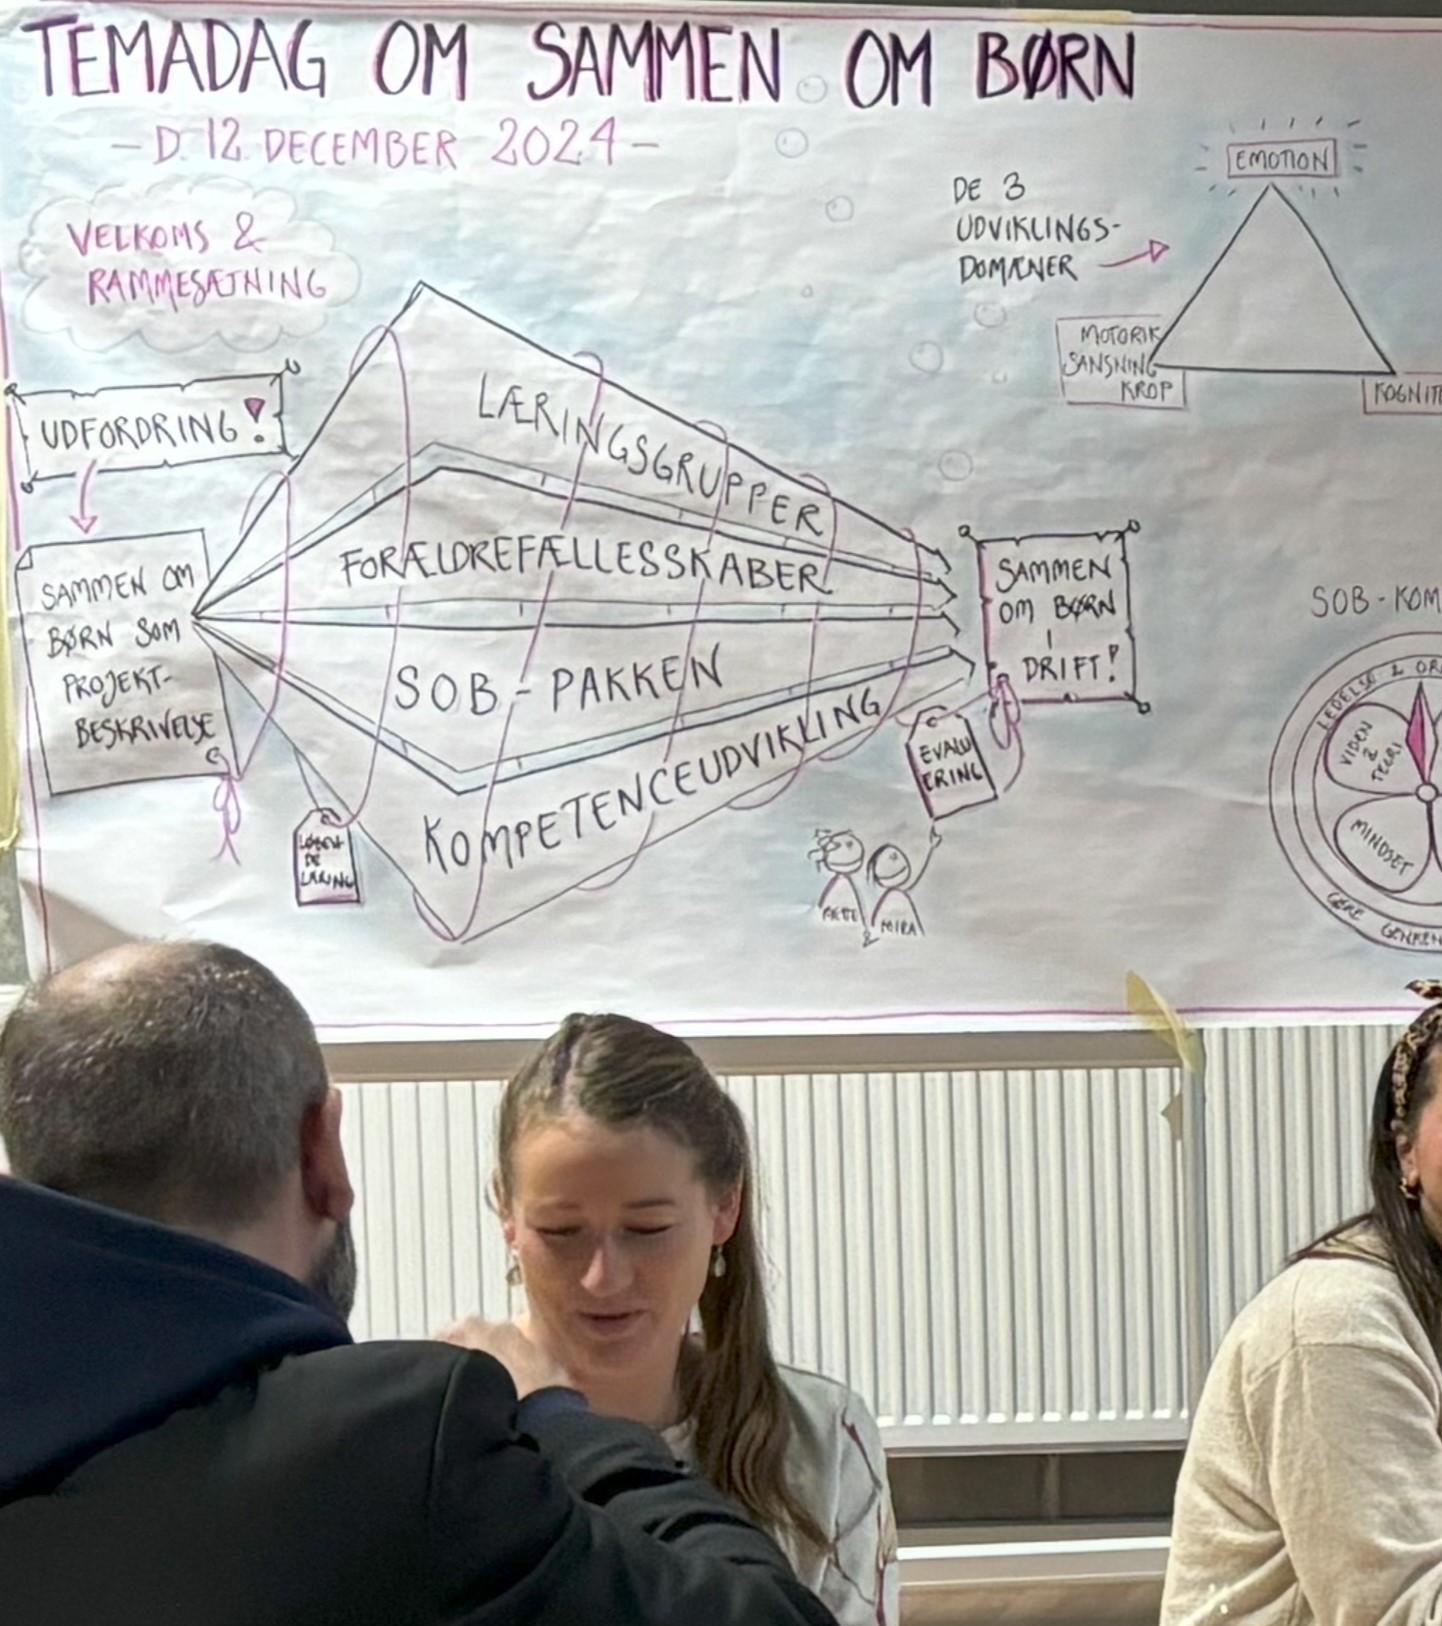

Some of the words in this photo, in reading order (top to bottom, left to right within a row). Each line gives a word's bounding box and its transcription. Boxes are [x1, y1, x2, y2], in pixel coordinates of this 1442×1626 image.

[22, 15, 326, 98] TEMADAG
[374, 22, 467, 100] OM
[526, 20, 781, 102] SAMMEN
[844, 28, 932, 107] OM
[976, 30, 1136, 101] BØRN
[264, 127, 459, 168] DECEMBER
[490, 116, 617, 166] 2024
[1235, 148, 1329, 172] EMOTION
[953, 177, 982, 202] DE
[1003, 172, 1026, 200] 3
[67, 220, 210, 256] VELKOMS
[234, 212, 267, 253] &
[956, 218, 1122, 243] UDVIKLINGS-
[87, 267, 327, 311] RAMMESÆTNING
[959, 255, 1078, 285] DOMÆNER
[1081, 324, 1161, 346] MOTORIK
[1062, 351, 1157, 379] SANSNING
[1120, 380, 1173, 402] KROP
[477, 371, 823, 536] LÆRINGSGRUPPER
[338, 534, 835, 595] FORÆLDREFÆLLESSKABER
[996, 553, 1112, 594] SAMMEN
[41, 566, 148, 612] SAMMEN
[161, 563, 195, 592] OM
[999, 598, 1035, 624] OM
[1055, 594, 1116, 622] BØRN
[47, 624, 115, 660] BØRN
[135, 620, 181, 649] SOM
[423, 686, 883, 874] KOMPETENCEUDVIKLING
[1350, 818, 1415, 877] MINDSET
